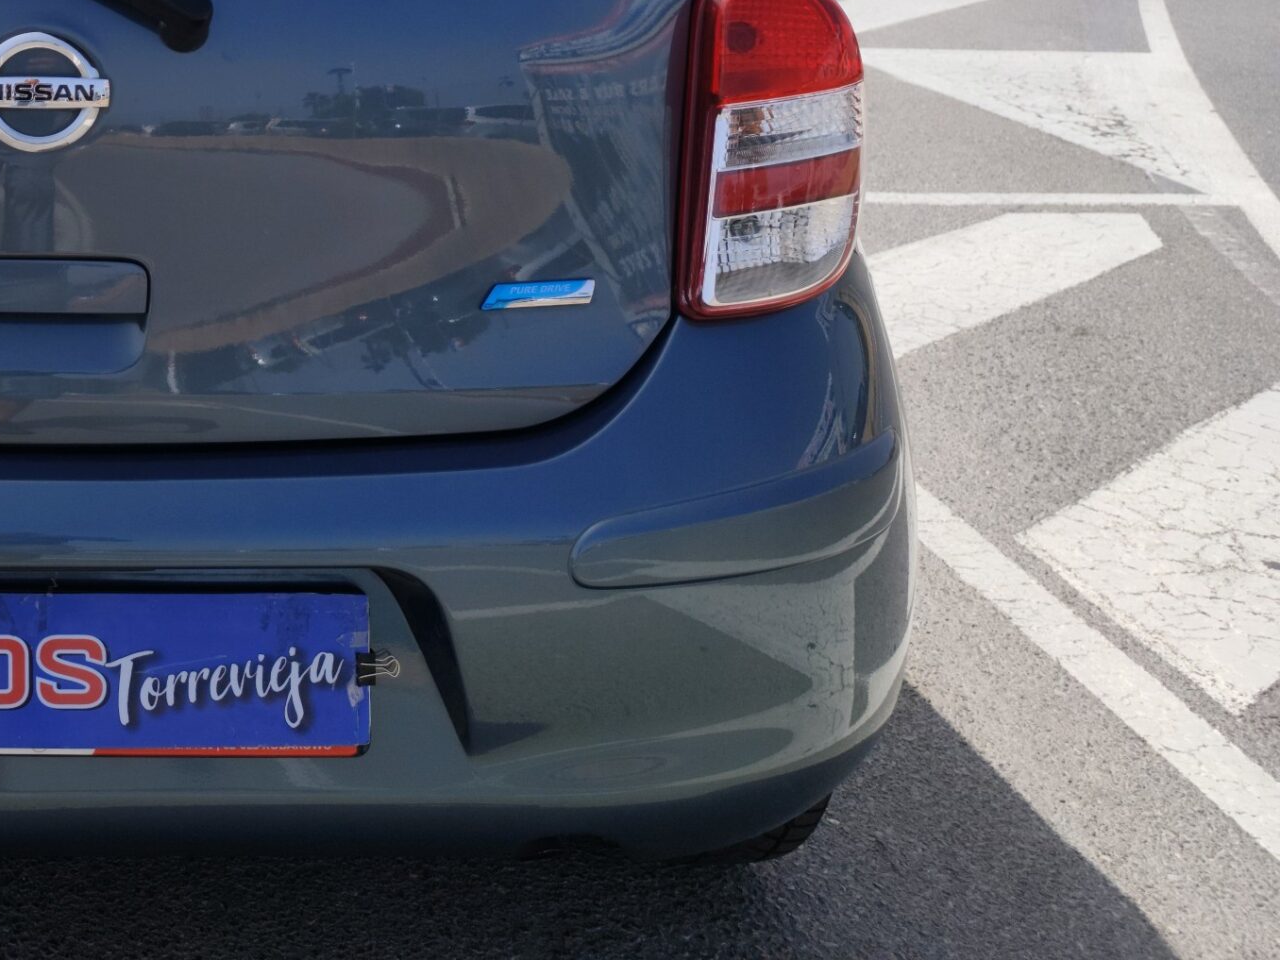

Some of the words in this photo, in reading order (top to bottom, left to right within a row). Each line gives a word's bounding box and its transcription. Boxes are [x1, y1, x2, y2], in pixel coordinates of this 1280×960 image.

[510, 285, 537, 295] PURE
[540, 283, 571, 293] DRIVE
[106, 646, 344, 729] Torrevieja
